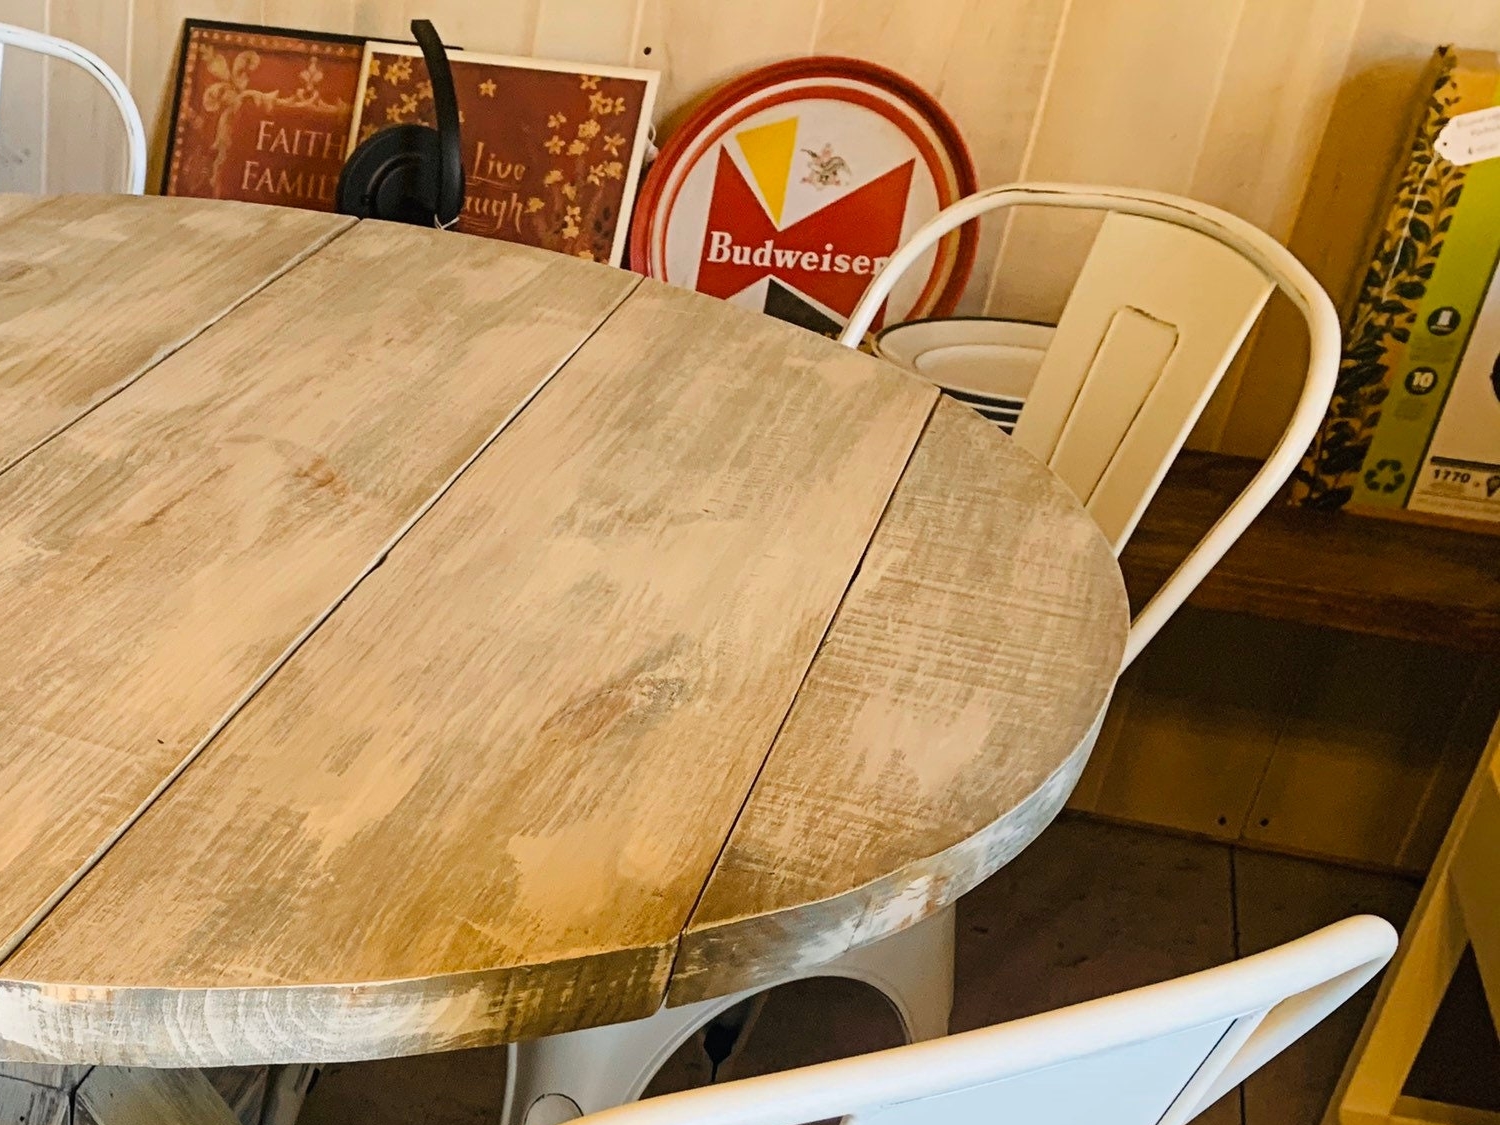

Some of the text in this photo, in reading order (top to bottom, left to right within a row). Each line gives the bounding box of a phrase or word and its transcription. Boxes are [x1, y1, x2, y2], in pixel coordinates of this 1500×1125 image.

[256, 120, 347, 160] FAITH
[241, 160, 341, 200] FAMIL
[468, 141, 526, 186] Live
[463, 192, 523, 235] augh
[706, 230, 891, 275] Budweiser
